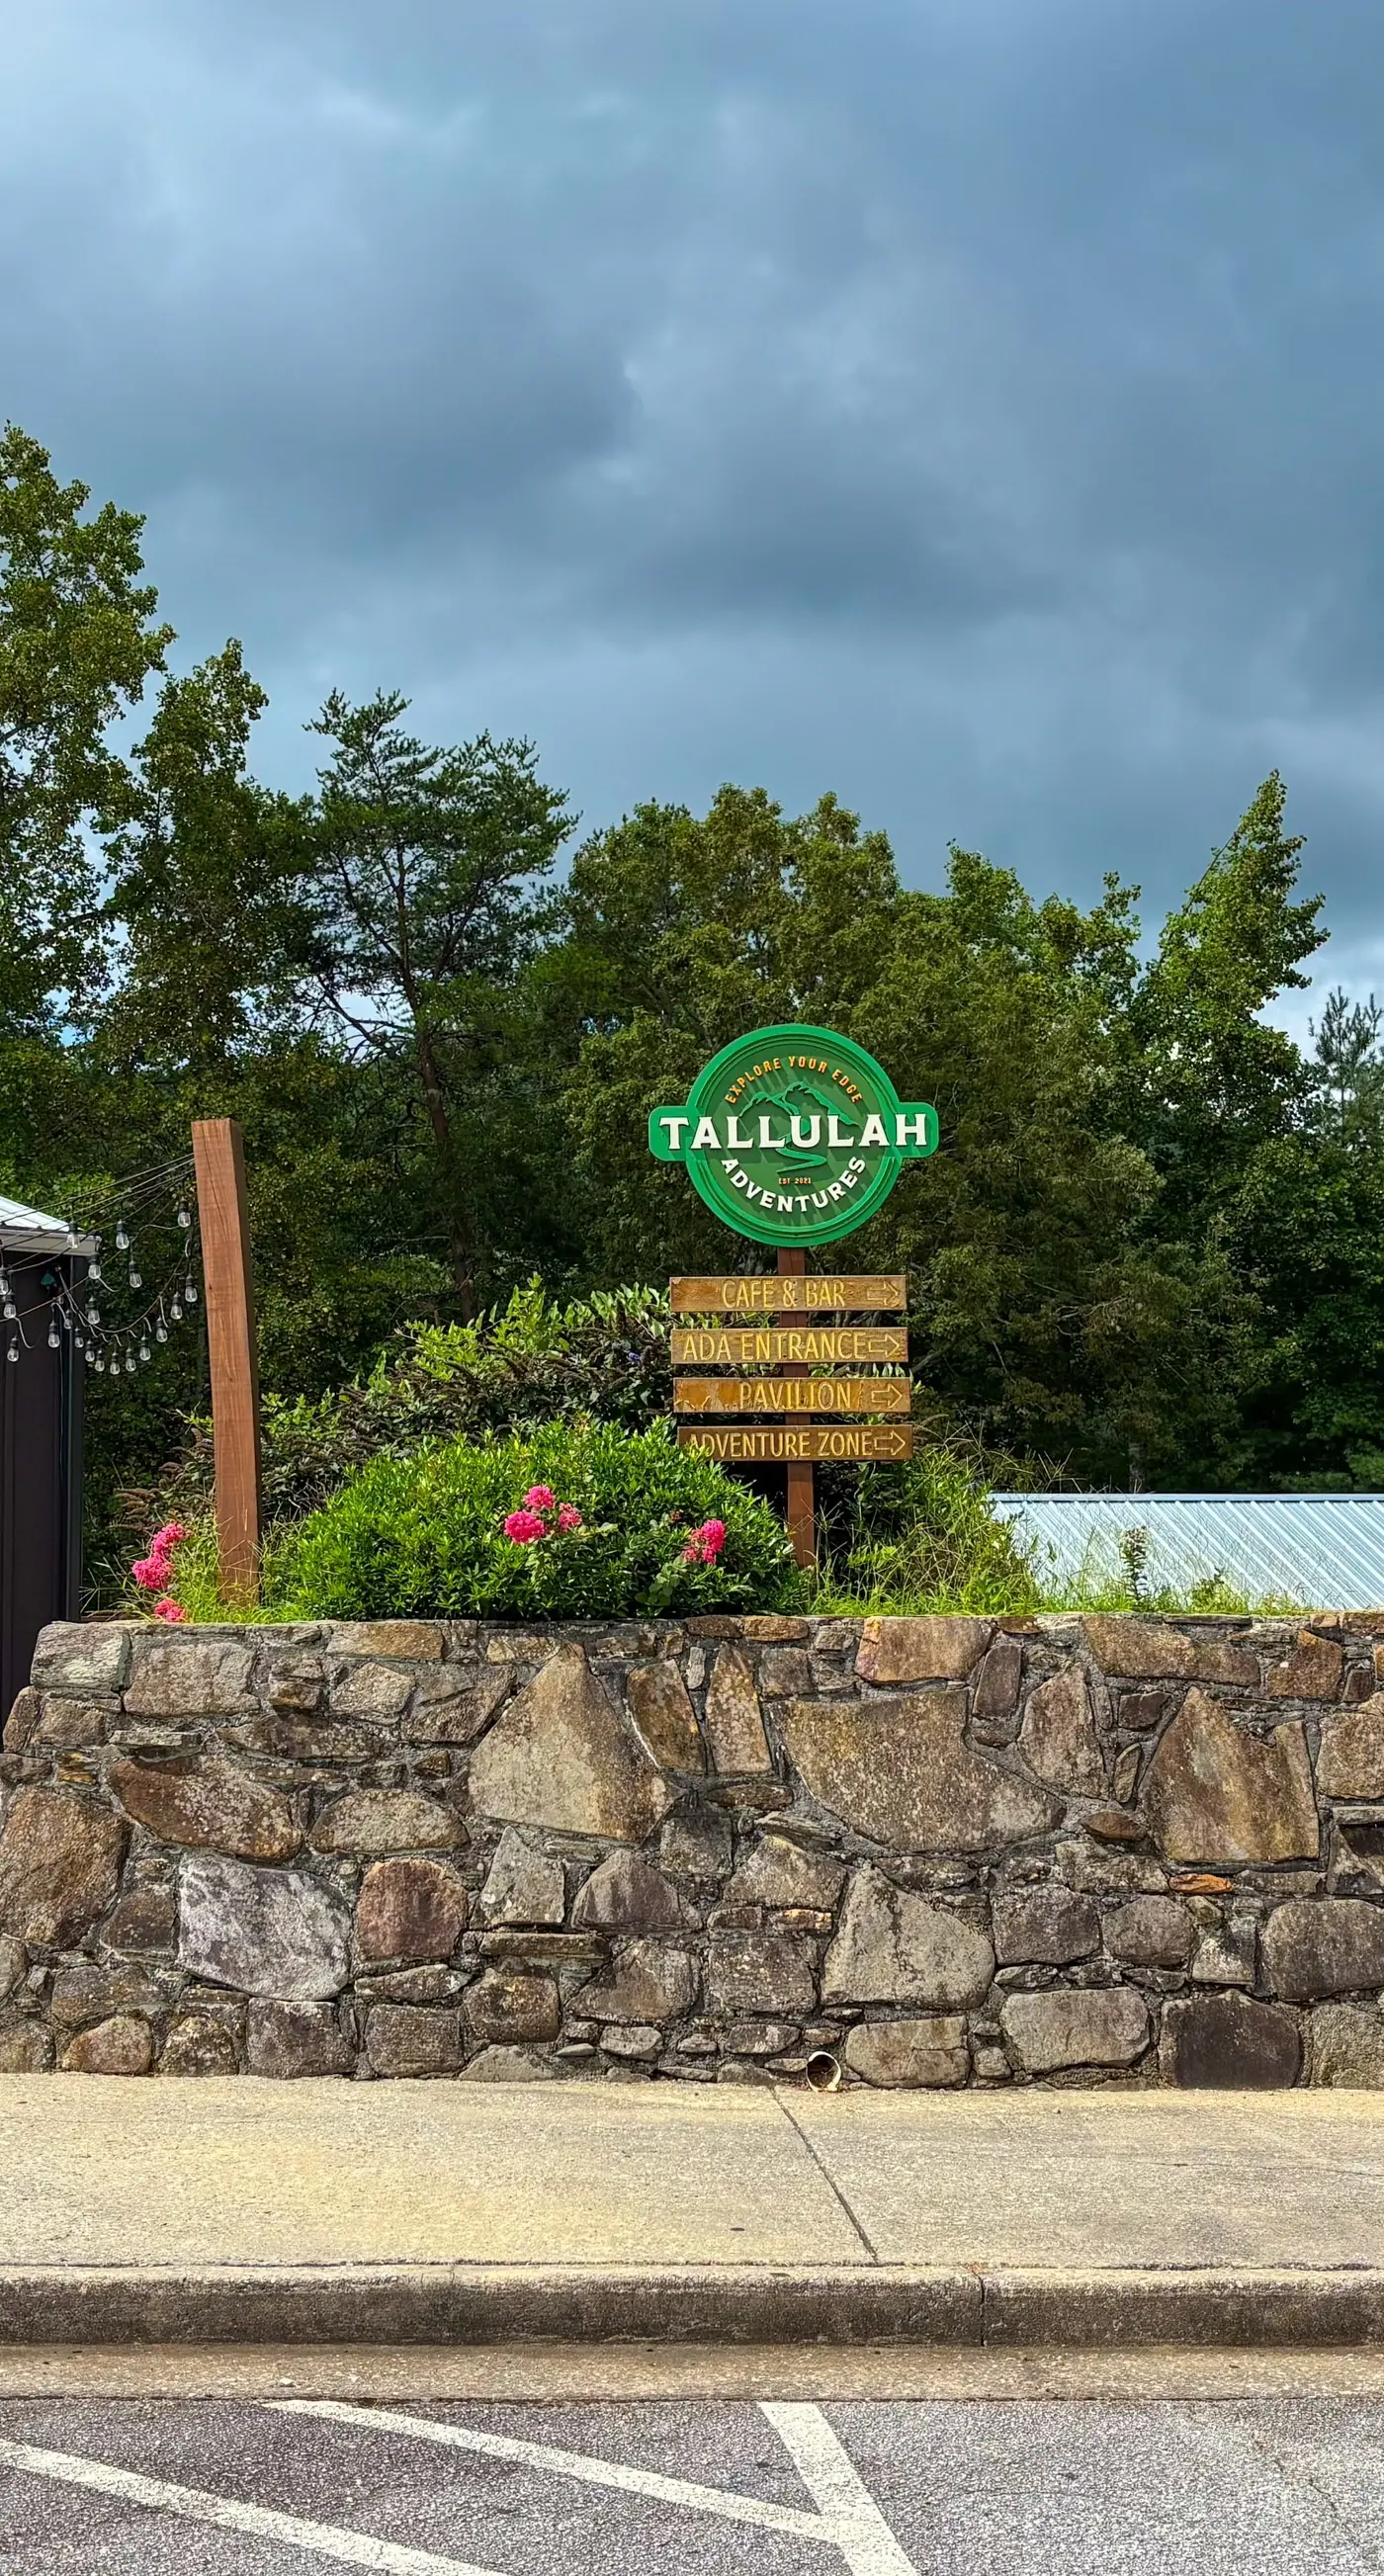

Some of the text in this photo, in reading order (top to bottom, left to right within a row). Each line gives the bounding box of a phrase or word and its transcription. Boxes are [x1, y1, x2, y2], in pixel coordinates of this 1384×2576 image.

[725, 1056, 864, 1104] EXPLORE YOUR EDGE
[658, 1113, 928, 1151] TALLULAH
[721, 1156, 867, 1213] ADVENTURES
[723, 1279, 846, 1308] CAFE & BAR
[683, 1331, 867, 1361] ADA ENTRANCE
[739, 1382, 851, 1411] PAVILION
[818, 1431, 873, 1457] ZONE
